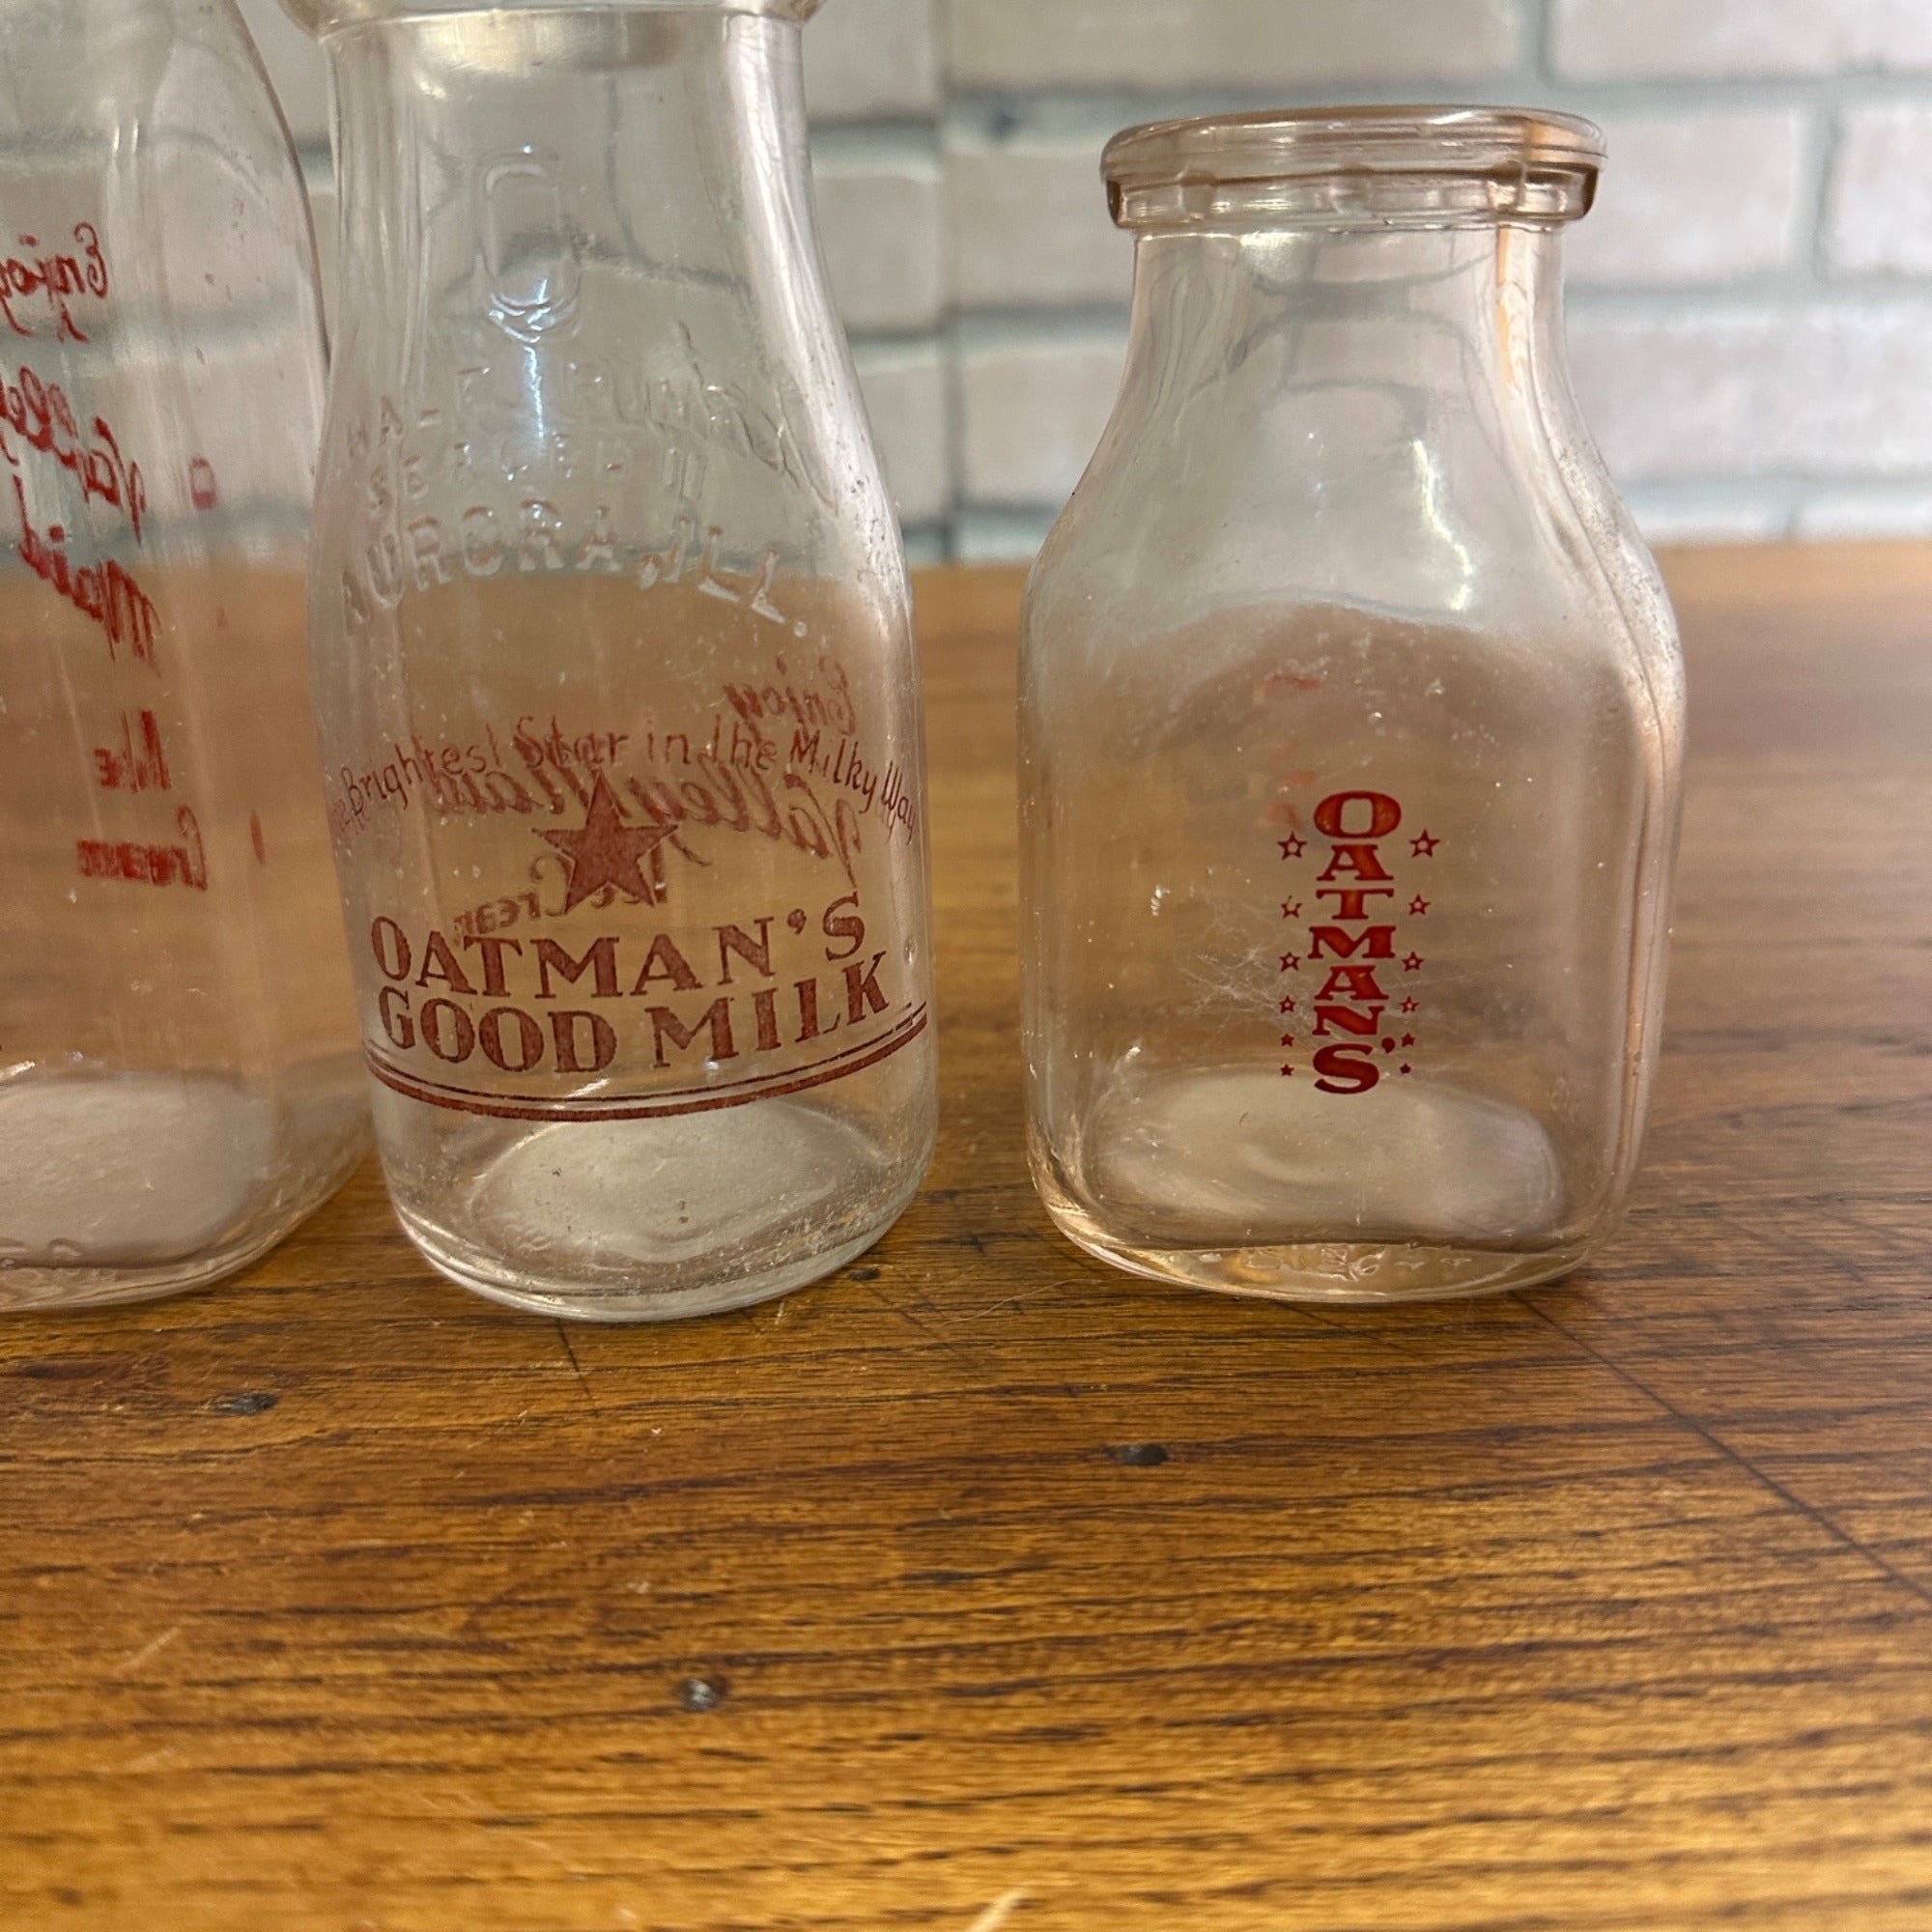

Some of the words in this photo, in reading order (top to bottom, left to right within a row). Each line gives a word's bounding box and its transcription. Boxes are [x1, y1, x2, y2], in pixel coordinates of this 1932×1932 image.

[341, 723, 502, 811] Brightest
[513, 714, 631, 771] Star
[644, 721, 692, 766] in
[789, 727, 878, 814] Milky
[370, 891, 867, 1001] OATMAN'S
[1306, 789, 1403, 1095] OATMAN'S
[378, 984, 619, 1075] GOOD
[643, 950, 892, 1069] MILK
